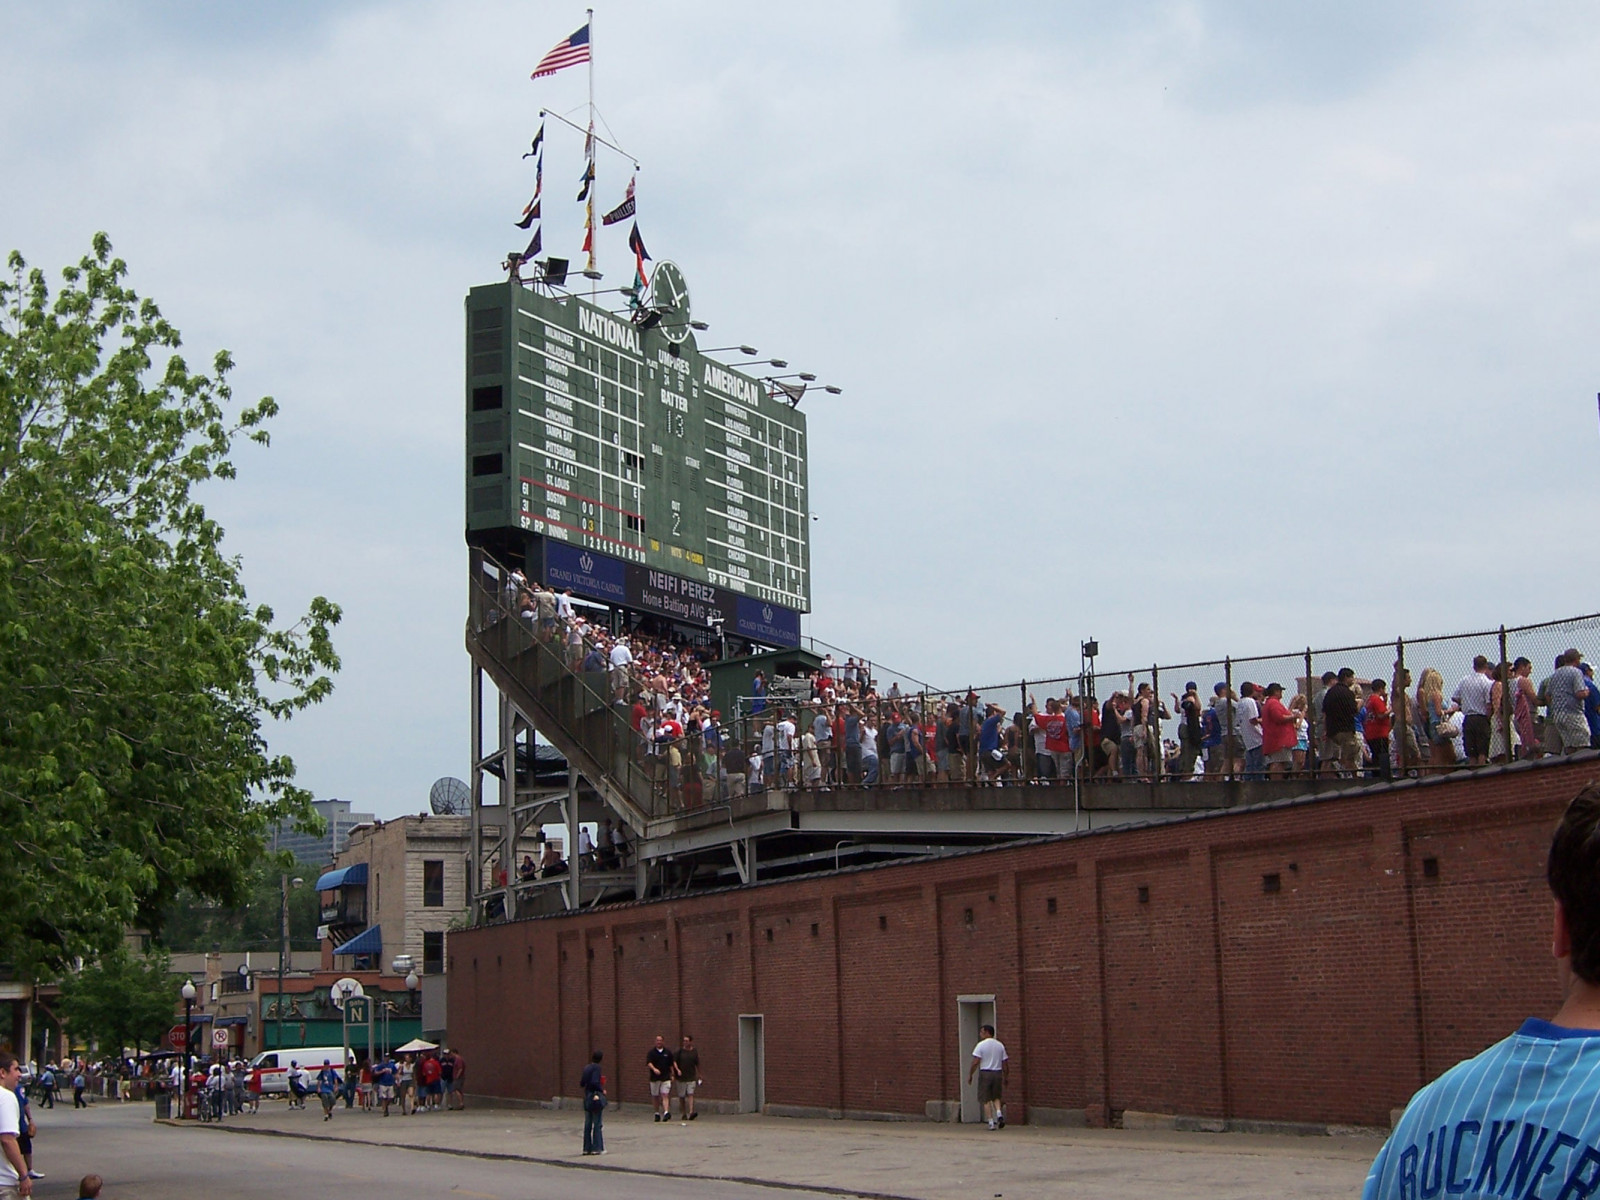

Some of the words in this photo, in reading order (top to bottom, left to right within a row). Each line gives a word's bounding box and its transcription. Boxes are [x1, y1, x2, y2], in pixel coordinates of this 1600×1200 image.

[609, 200, 634, 222] PHILLIES
[579, 306, 643, 356] NATIONAL
[545, 358, 568, 377] TORONTO
[658, 349, 690, 375] UMPIRES
[545, 374, 569, 393] HOUSTON
[703, 363, 759, 407] AMERICAN
[545, 391, 573, 411] BALTIMORE
[660, 388, 688, 413] BATTER
[545, 407, 574, 428] CINCINNATI
[667, 410, 684, 438] 13
[563, 430, 573, 444] BAY
[545, 440, 577, 461] PITTSBURGH
[651, 443, 663, 456] BALL
[554, 476, 570, 491] LOUIS
[546, 490, 567, 507] BOSTON
[671, 500, 680, 512] OUT
[546, 506, 560, 521] CUBS
[520, 515, 530, 529] SP
[534, 519, 544, 533] RP
[548, 524, 568, 540] INNING
[672, 512, 681, 537] 2
[549, 567, 572, 582] GRAND
[572, 573, 600, 589] VICTORIA
[600, 581, 624, 595] CASINO
[708, 572, 717, 584] SP
[719, 576, 727, 588] RP
[728, 563, 737, 577] SAN
[737, 566, 750, 579] DIEGO
[649, 570, 678, 594] NEIFI
[681, 580, 715, 604] PEREZ
[642, 589, 662, 608] Home
[663, 595, 689, 618] Batting
[690, 603, 705, 619] AVG
[351, 1007, 362, 1022] N
[171, 1031, 186, 1041] STO
[1400, 1119, 1600, 1200] BUCKNER
